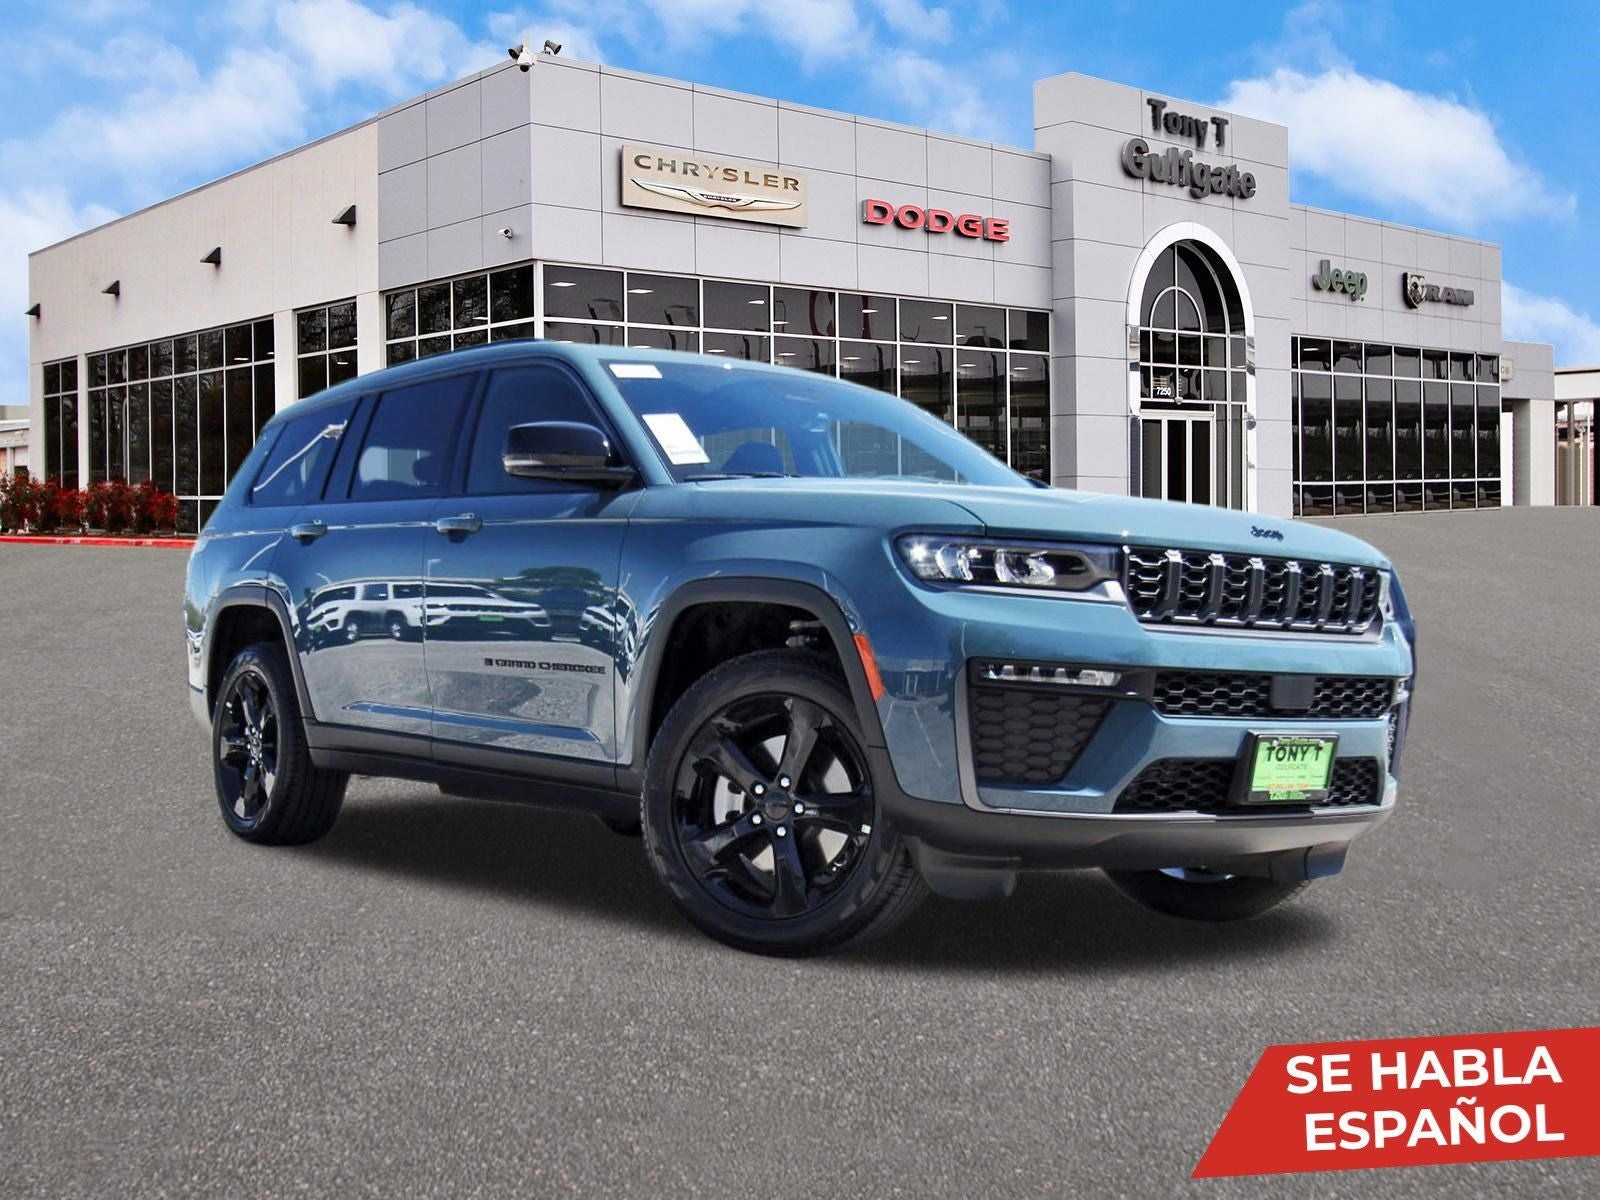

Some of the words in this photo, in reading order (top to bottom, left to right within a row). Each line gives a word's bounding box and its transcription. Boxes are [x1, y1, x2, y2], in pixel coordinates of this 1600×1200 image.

[1146, 98, 1208, 148] Tony
[1210, 116, 1229, 147] T
[634, 154, 800, 192] CHRYSLER
[1121, 138, 1256, 199] Gulfgate
[863, 199, 1011, 243] DODGE
[1312, 259, 1368, 302] Jeep
[1425, 283, 1475, 306] RAM
[1156, 386, 1172, 396] 7250
[1266, 745, 1310, 762] TONY
[1314, 745, 1324, 762] T
